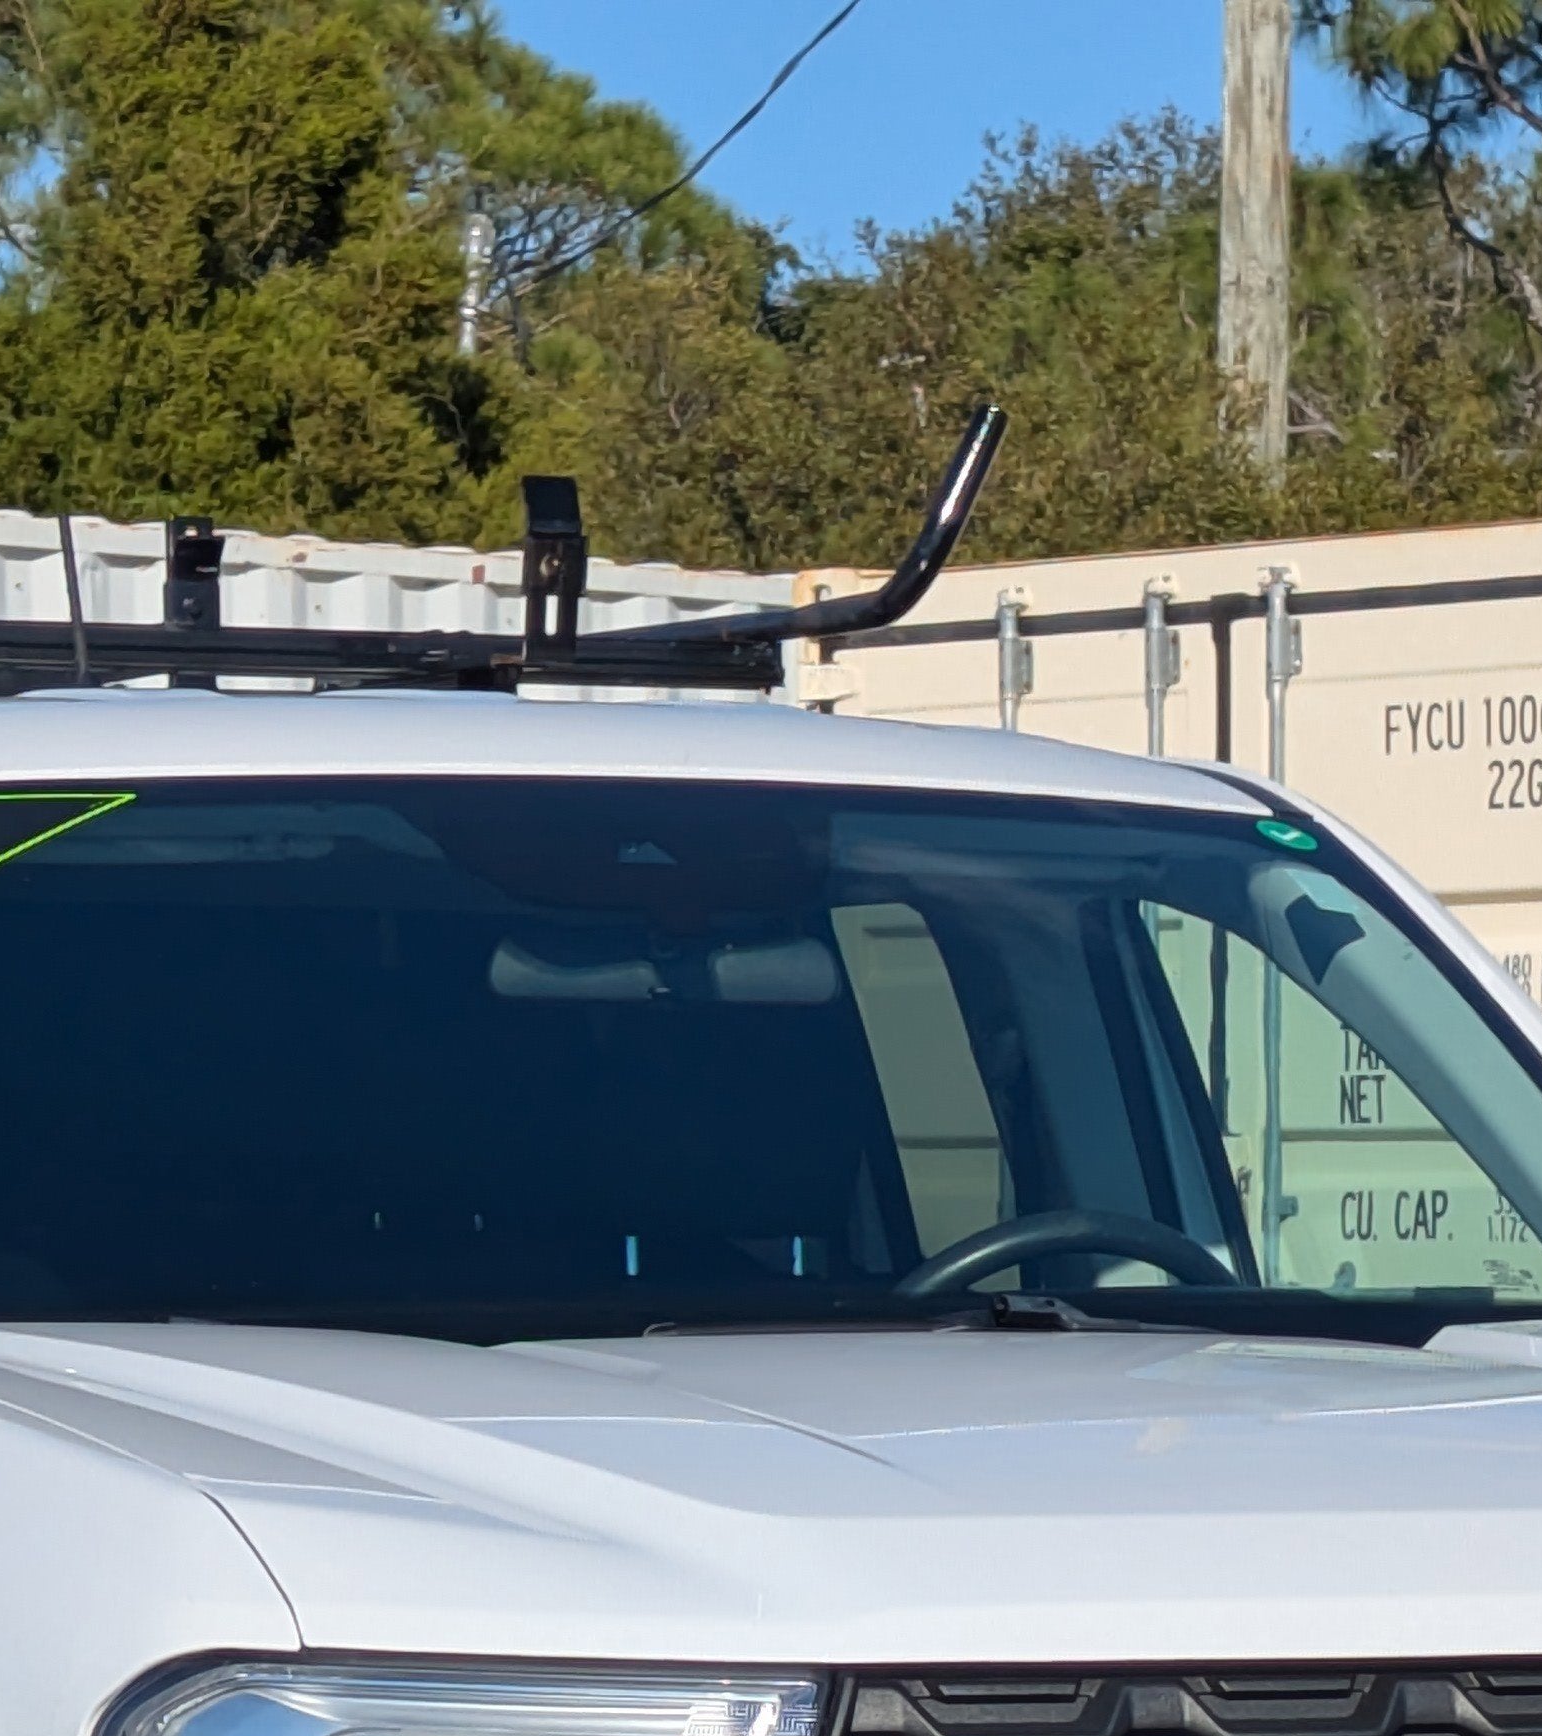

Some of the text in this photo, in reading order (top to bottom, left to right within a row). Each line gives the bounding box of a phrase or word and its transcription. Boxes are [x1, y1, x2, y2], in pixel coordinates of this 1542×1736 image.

[1384, 698, 1465, 755] FYCU
[1340, 1074, 1386, 1124] NET
[1340, 1190, 1454, 1241] CU. CAP.
